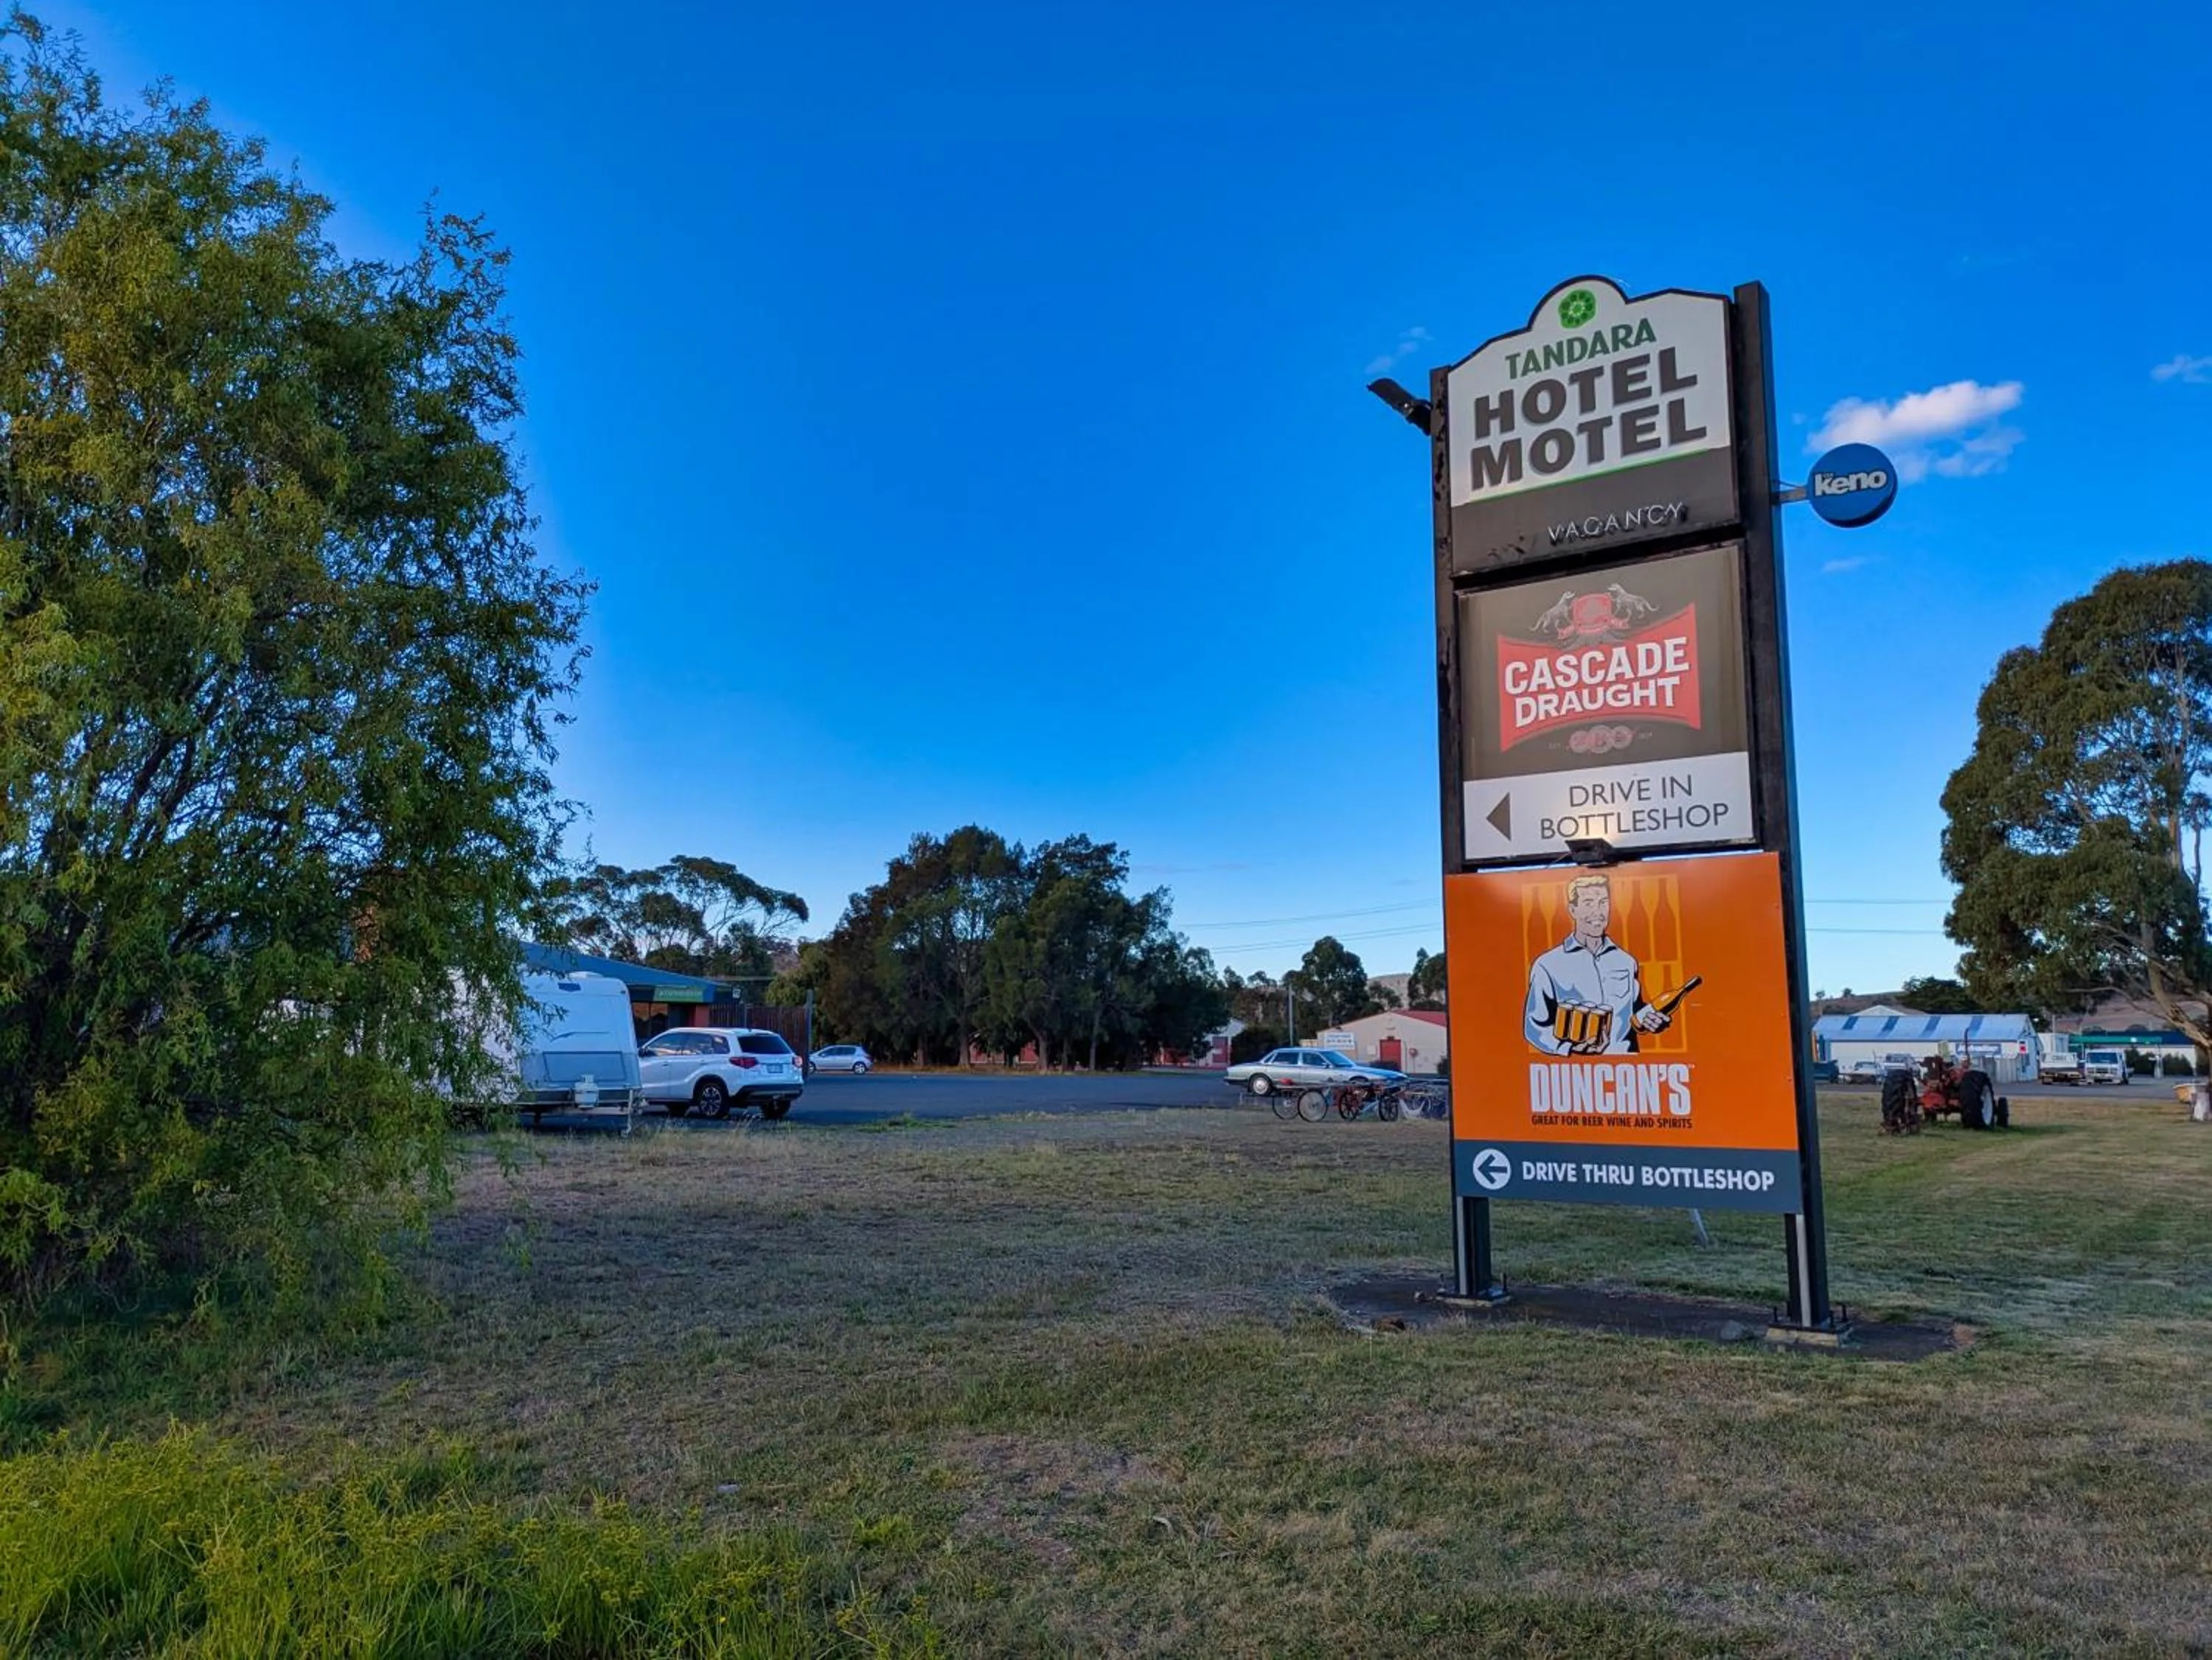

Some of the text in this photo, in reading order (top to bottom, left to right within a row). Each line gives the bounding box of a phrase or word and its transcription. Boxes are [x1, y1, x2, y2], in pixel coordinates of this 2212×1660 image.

[1505, 317, 1657, 380] TANDARA
[1474, 347, 1698, 439] HOTEL
[1470, 399, 1708, 492] MOTEL
[1815, 471, 1887, 496] keno
[1548, 501, 1684, 543] VACANCY
[1504, 636, 1690, 695] CASCADE
[1514, 676, 1680, 728] DRAUGHT
[1569, 774, 1693, 808] DRIVE IN
[1540, 803, 1729, 840] BOTTLESHOP
[1529, 1063, 1691, 1115] DUNCAN'S
[1531, 1115, 1692, 1129] GREAT FOR BEER WINE AND SPIRITS
[1522, 1161, 1775, 1191] DRIVE THRU BOTTLESHOP
